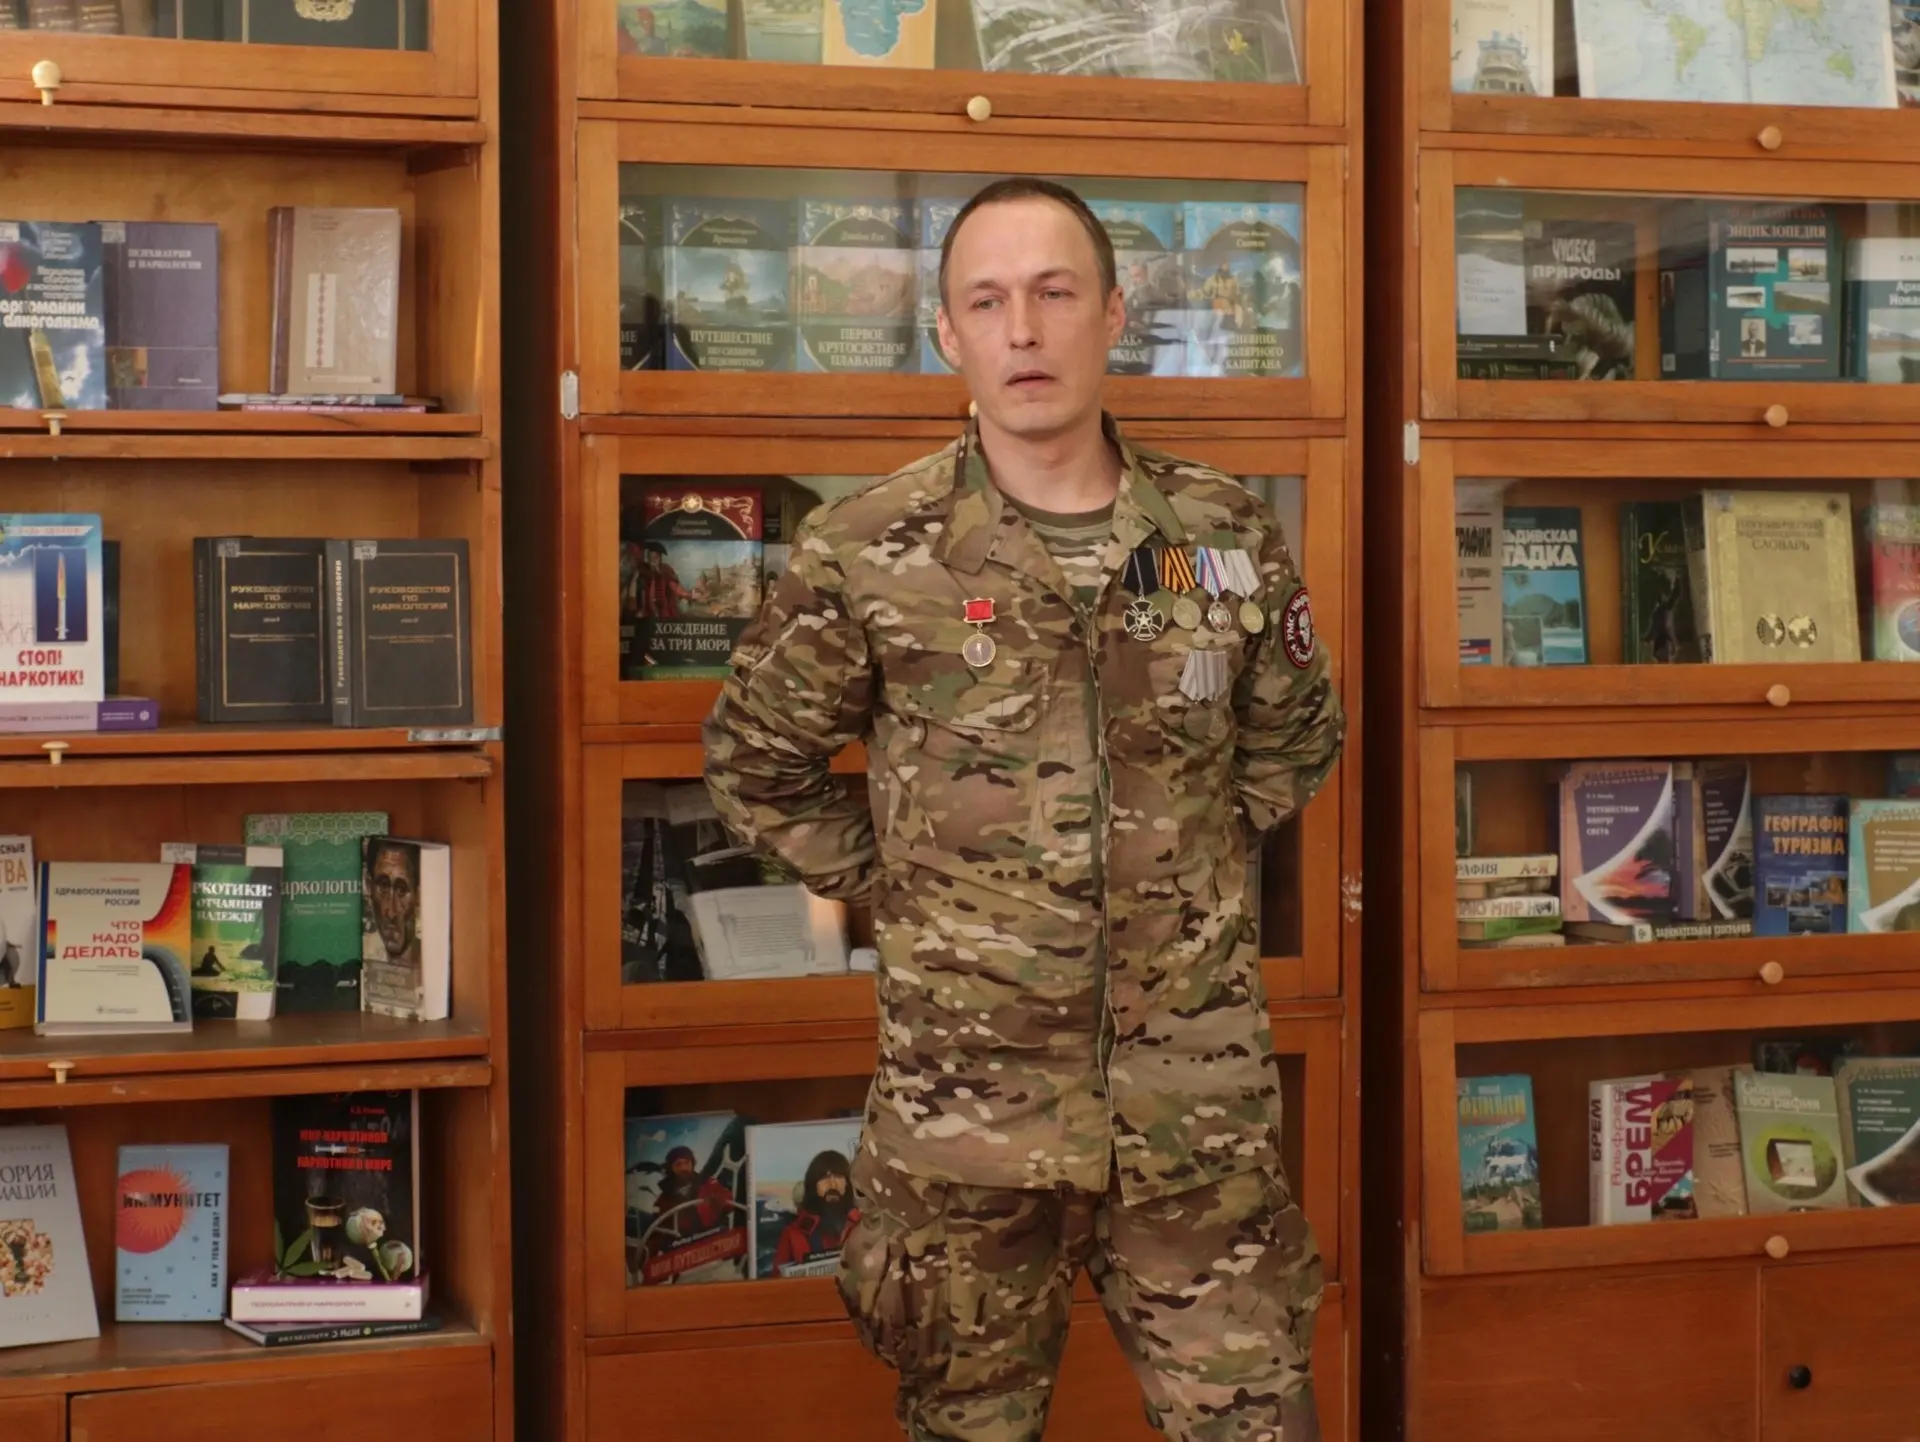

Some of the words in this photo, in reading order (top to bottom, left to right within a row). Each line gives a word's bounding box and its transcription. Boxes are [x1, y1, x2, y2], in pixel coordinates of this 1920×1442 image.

[1552, 238, 1596, 264] ЧУДЕСА
[1533, 265, 1621, 281] ПРИРОДЫ
[690, 330, 774, 345] ПУТЕШЕСТВИЕ
[840, 328, 884, 341] ПЕРВОЕ
[831, 355, 894, 367] ПЛАВАНИЕ
[1752, 539, 1810, 551] СЛОВАРЬ
[1502, 544, 1579, 569] ГАДКА
[369, 585, 451, 594] РУКОВОДСТВО
[655, 622, 728, 636] ХОЖДЕНИЕ
[651, 639, 665, 651] ЗА
[668, 638, 692, 651] ТРИ
[695, 639, 731, 651] МОРЯ
[18, 650, 62, 666] СТОП!
[0, 670, 84, 687] НАРКОТИК!
[1764, 815, 1848, 833] ГЕОГРАФИ
[1773, 837, 1845, 855] ТУРИЗМА
[192, 881, 273, 898] РКОТИКИ:
[281, 879, 362, 901] аркологи
[104, 898, 140, 907] РОССИИ
[111, 921, 140, 931] ЧТО
[92, 934, 140, 943] НАДО
[63, 946, 140, 960] ДЕЛАТЬ
[1590, 1098, 1602, 1162] БРЕМ
[1625, 1084, 1653, 1207] БРЕМ
[0, 1163, 55, 1184] ОРИЯ
